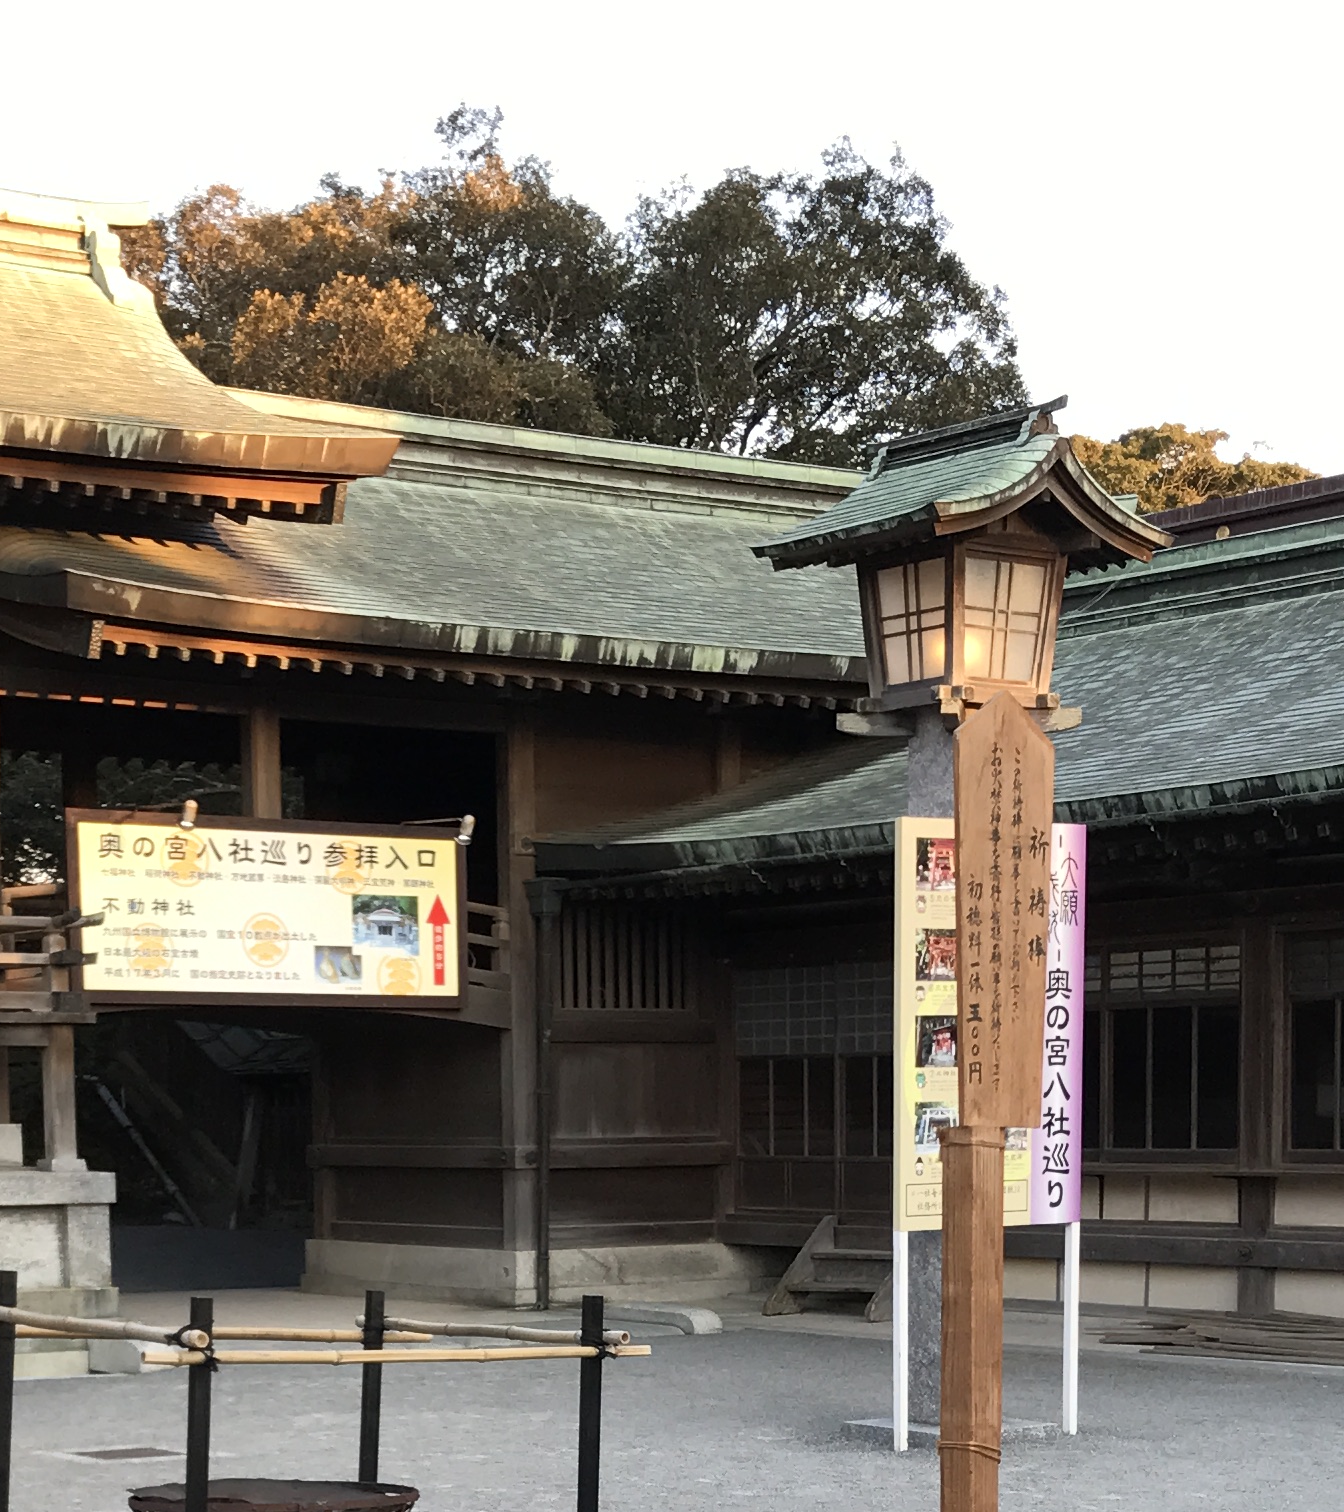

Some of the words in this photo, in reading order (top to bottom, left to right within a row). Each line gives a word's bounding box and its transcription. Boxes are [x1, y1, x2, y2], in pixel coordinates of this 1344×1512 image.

[98, 833, 437, 870] 奥の宮八社巡り参拝入口
[102, 898, 195, 916] 不動神社
[1060, 852, 1079, 926] 大願
[1042, 968, 1072, 1209] 奥の宮八社巡り
